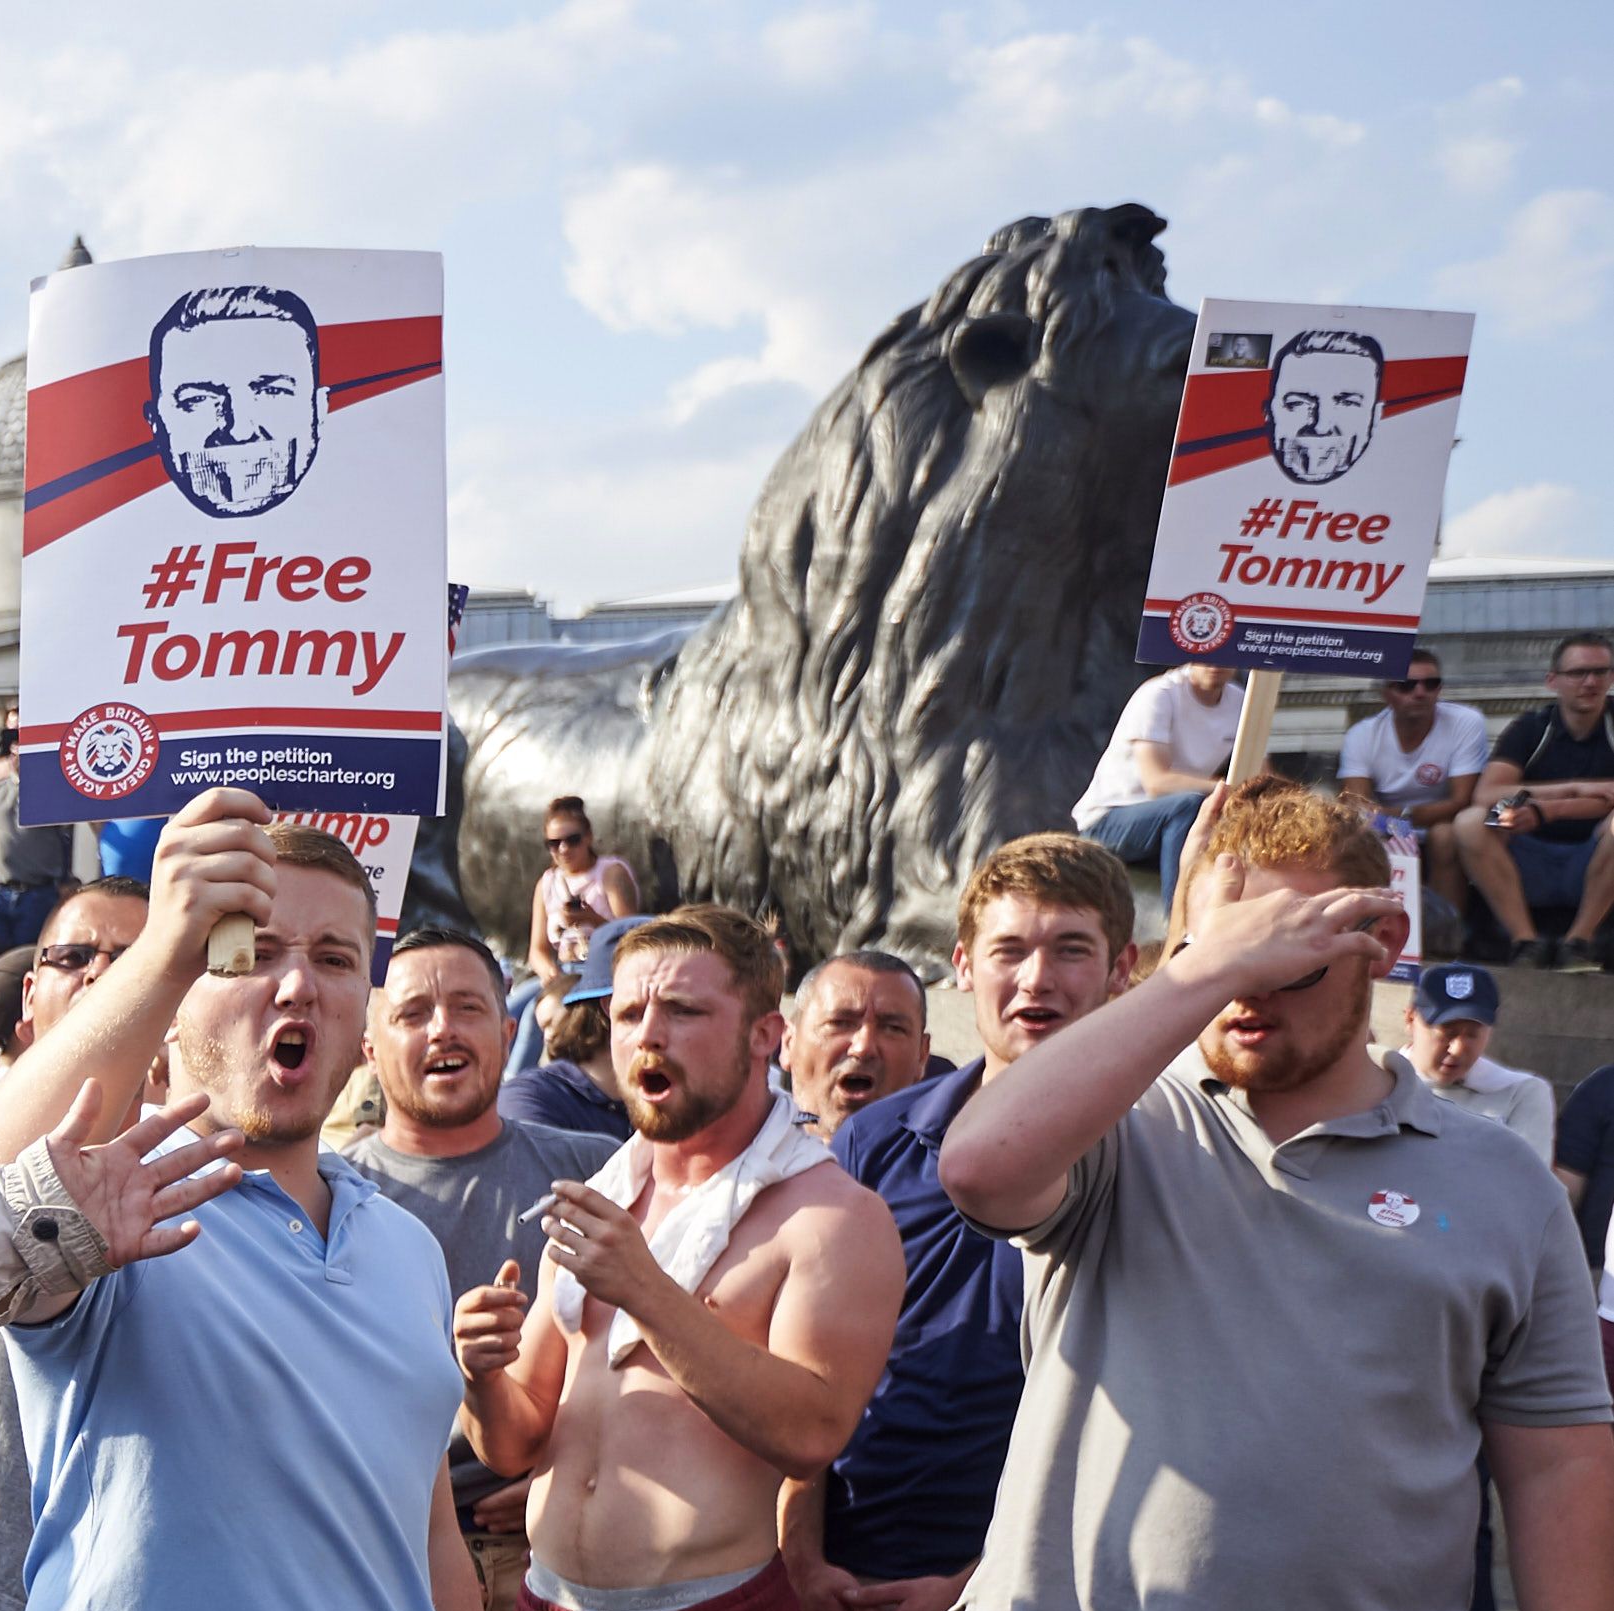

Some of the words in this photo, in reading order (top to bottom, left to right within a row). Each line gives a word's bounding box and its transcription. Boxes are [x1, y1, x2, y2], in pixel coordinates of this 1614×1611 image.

[1240, 498, 1391, 544] #Free
[142, 541, 372, 609] #Free
[1217, 543, 1405, 605] Tommy
[1236, 643, 1383, 663] www.peoplescharter.org
[1244, 630, 1271, 644] Sign
[1273, 632, 1293, 644] the
[1295, 635, 1343, 647] petition
[116, 621, 406, 696] Tommy
[65, 711, 100, 748] MAKE
[105, 707, 154, 742] BRITAIN
[111, 758, 151, 795] GREAT
[180, 750, 222, 769] Sign
[226, 748, 257, 764] the
[261, 748, 333, 766] petition
[65, 763, 105, 795] AGAIN
[170, 765, 396, 789] www.peoplescharter.org
